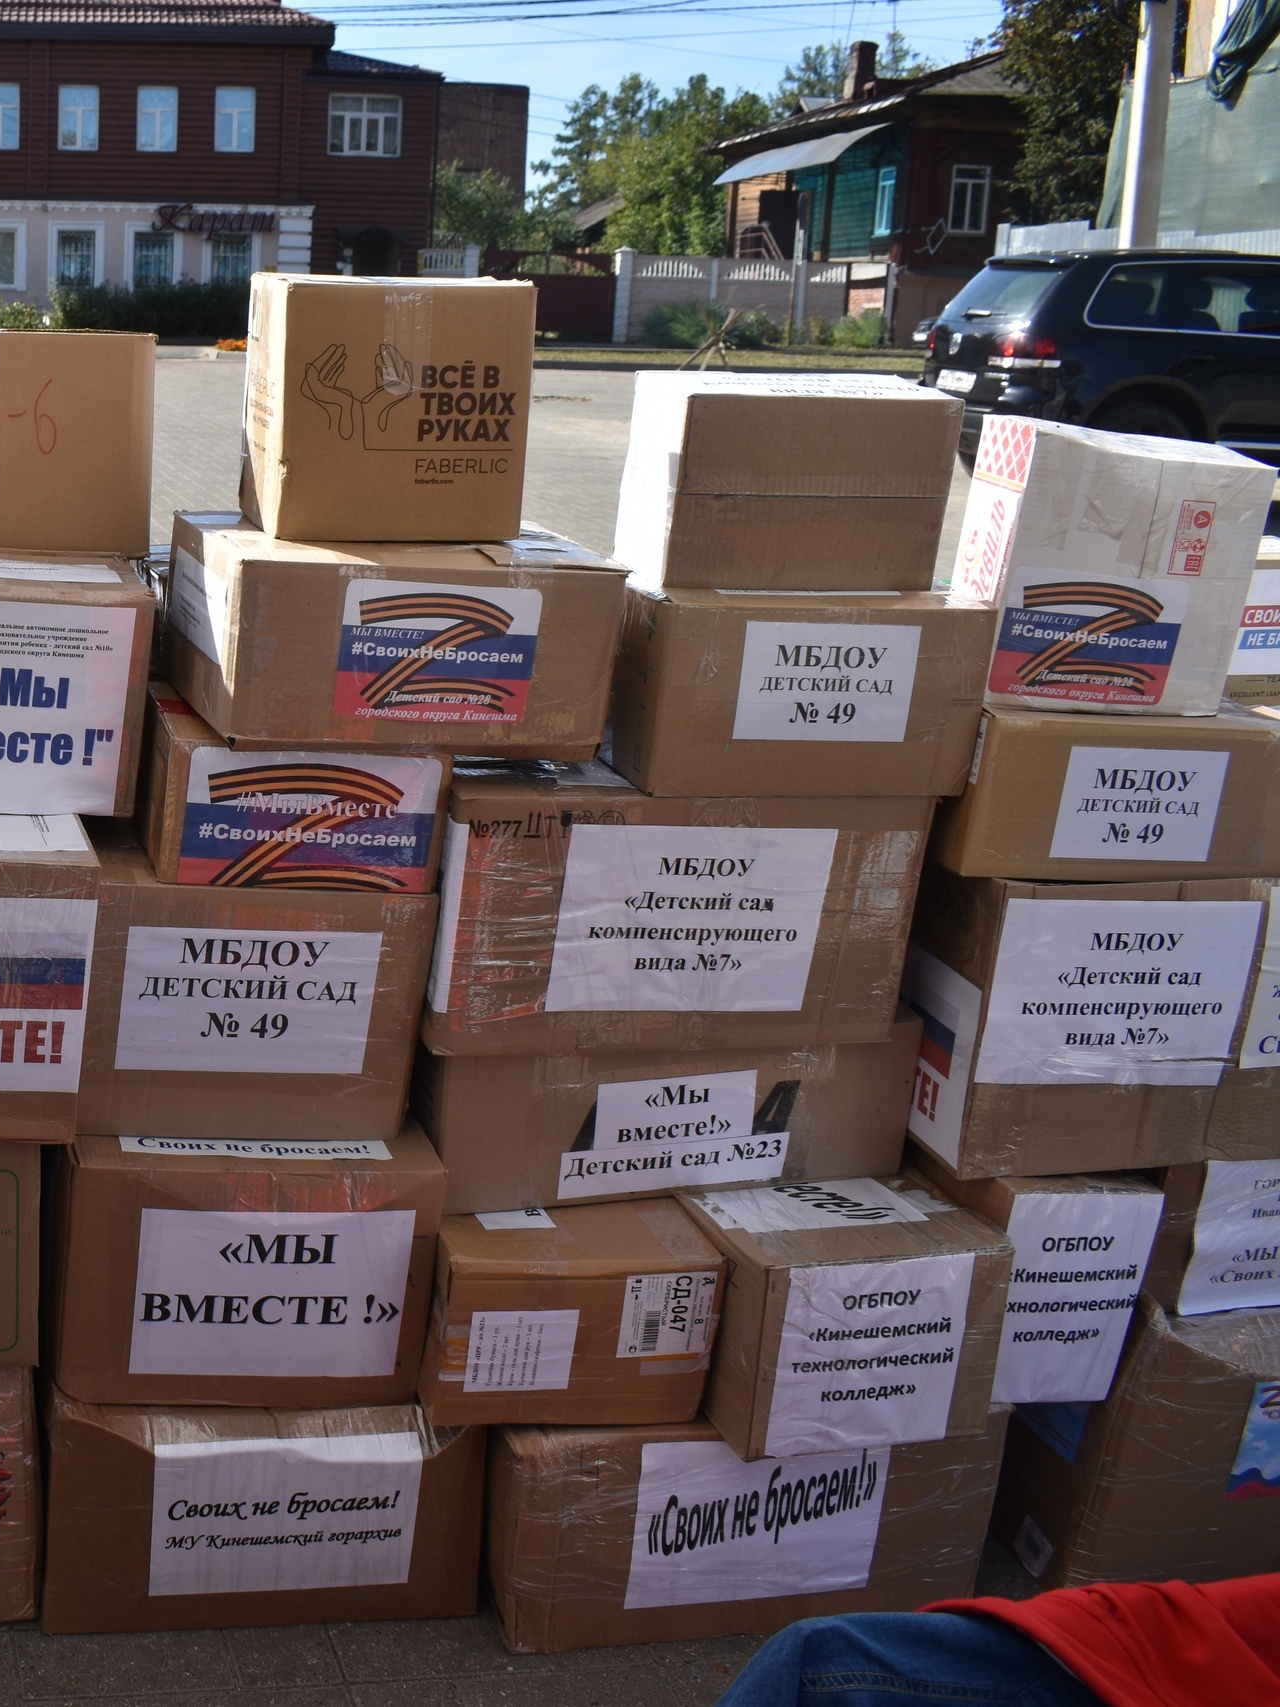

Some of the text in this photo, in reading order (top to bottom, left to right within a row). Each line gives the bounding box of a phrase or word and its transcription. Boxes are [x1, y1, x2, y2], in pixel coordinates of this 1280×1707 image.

[483, 365, 500, 388] В
[420, 392, 516, 415] ТВОИХ
[417, 419, 510, 442] РУКАХ
[415, 459, 508, 473] FABERLIC
[26, 625, 66, 633] автономное
[67, 627, 109, 636] дошкольное
[47, 635, 87, 643] учреждение
[351, 627, 424, 640] МЫ ВМЕСТЕ!
[1011, 623, 1168, 650] #СвоихНеБросаем
[1247, 633, 1263, 646] НЕ
[20, 641, 48, 649] ребенка
[53, 643, 80, 651] детский
[28, 650, 51, 659] округа
[52, 651, 84, 659] Кинешма
[352, 642, 523, 664] #СвоихНеБросаем
[774, 644, 888, 673] МБДОУ
[759, 675, 894, 696] ДЕТСКИЙ САД
[384, 691, 440, 704] Детский
[443, 694, 462, 704] сад
[355, 707, 518, 722] городского округа Кинешма
[789, 702, 856, 724] № 49
[236, 791, 398, 819] #МыВместе
[198, 823, 416, 847] #СвоихНеБросаем
[658, 857, 755, 879] МБДОУ
[624, 891, 774, 912] «Детский сад
[588, 925, 798, 945] компенсирующего
[1089, 932, 1183, 955] МБДОУ
[179, 937, 331, 972] МБДОУ
[634, 953, 743, 972] вида №7»
[1057, 967, 1202, 986] «Детский сад
[139, 975, 358, 1006] ДЕТСКИЙ САД
[1021, 1000, 1222, 1020] компенсирующего
[200, 1012, 288, 1039] № 49
[1064, 1028, 1170, 1047] вида №7»
[645, 1084, 710, 1108] «Мы
[617, 1114, 732, 1143] вместе!»
[137, 1137, 371, 1156] Своих не бросаем!
[564, 1139, 782, 1181] Детский сад №23
[219, 1234, 339, 1264] «МЫ
[1042, 1236, 1114, 1252] ОГБПОУ
[1231, 1247, 1278, 1264] «МЫ
[1209, 1270, 1273, 1284] «Своих
[139, 1293, 348, 1325] ВМЕСТЕ
[661, 1281, 673, 1327] СЕРЕБРИСТЫЙ
[669, 1276, 693, 1333] СД-047
[842, 1289, 921, 1311] ОГБПОУ
[1005, 1294, 1138, 1313] хнологический
[1013, 1328, 1099, 1344] колледж»
[792, 1348, 954, 1374] технологический
[820, 1383, 916, 1403] колледж»
[167, 1490, 401, 1521] Своих не бросаем!
[648, 1448, 878, 1556] «Своих не бросаем!»
[165, 1527, 402, 1550] МУ Кинешемский горархив
